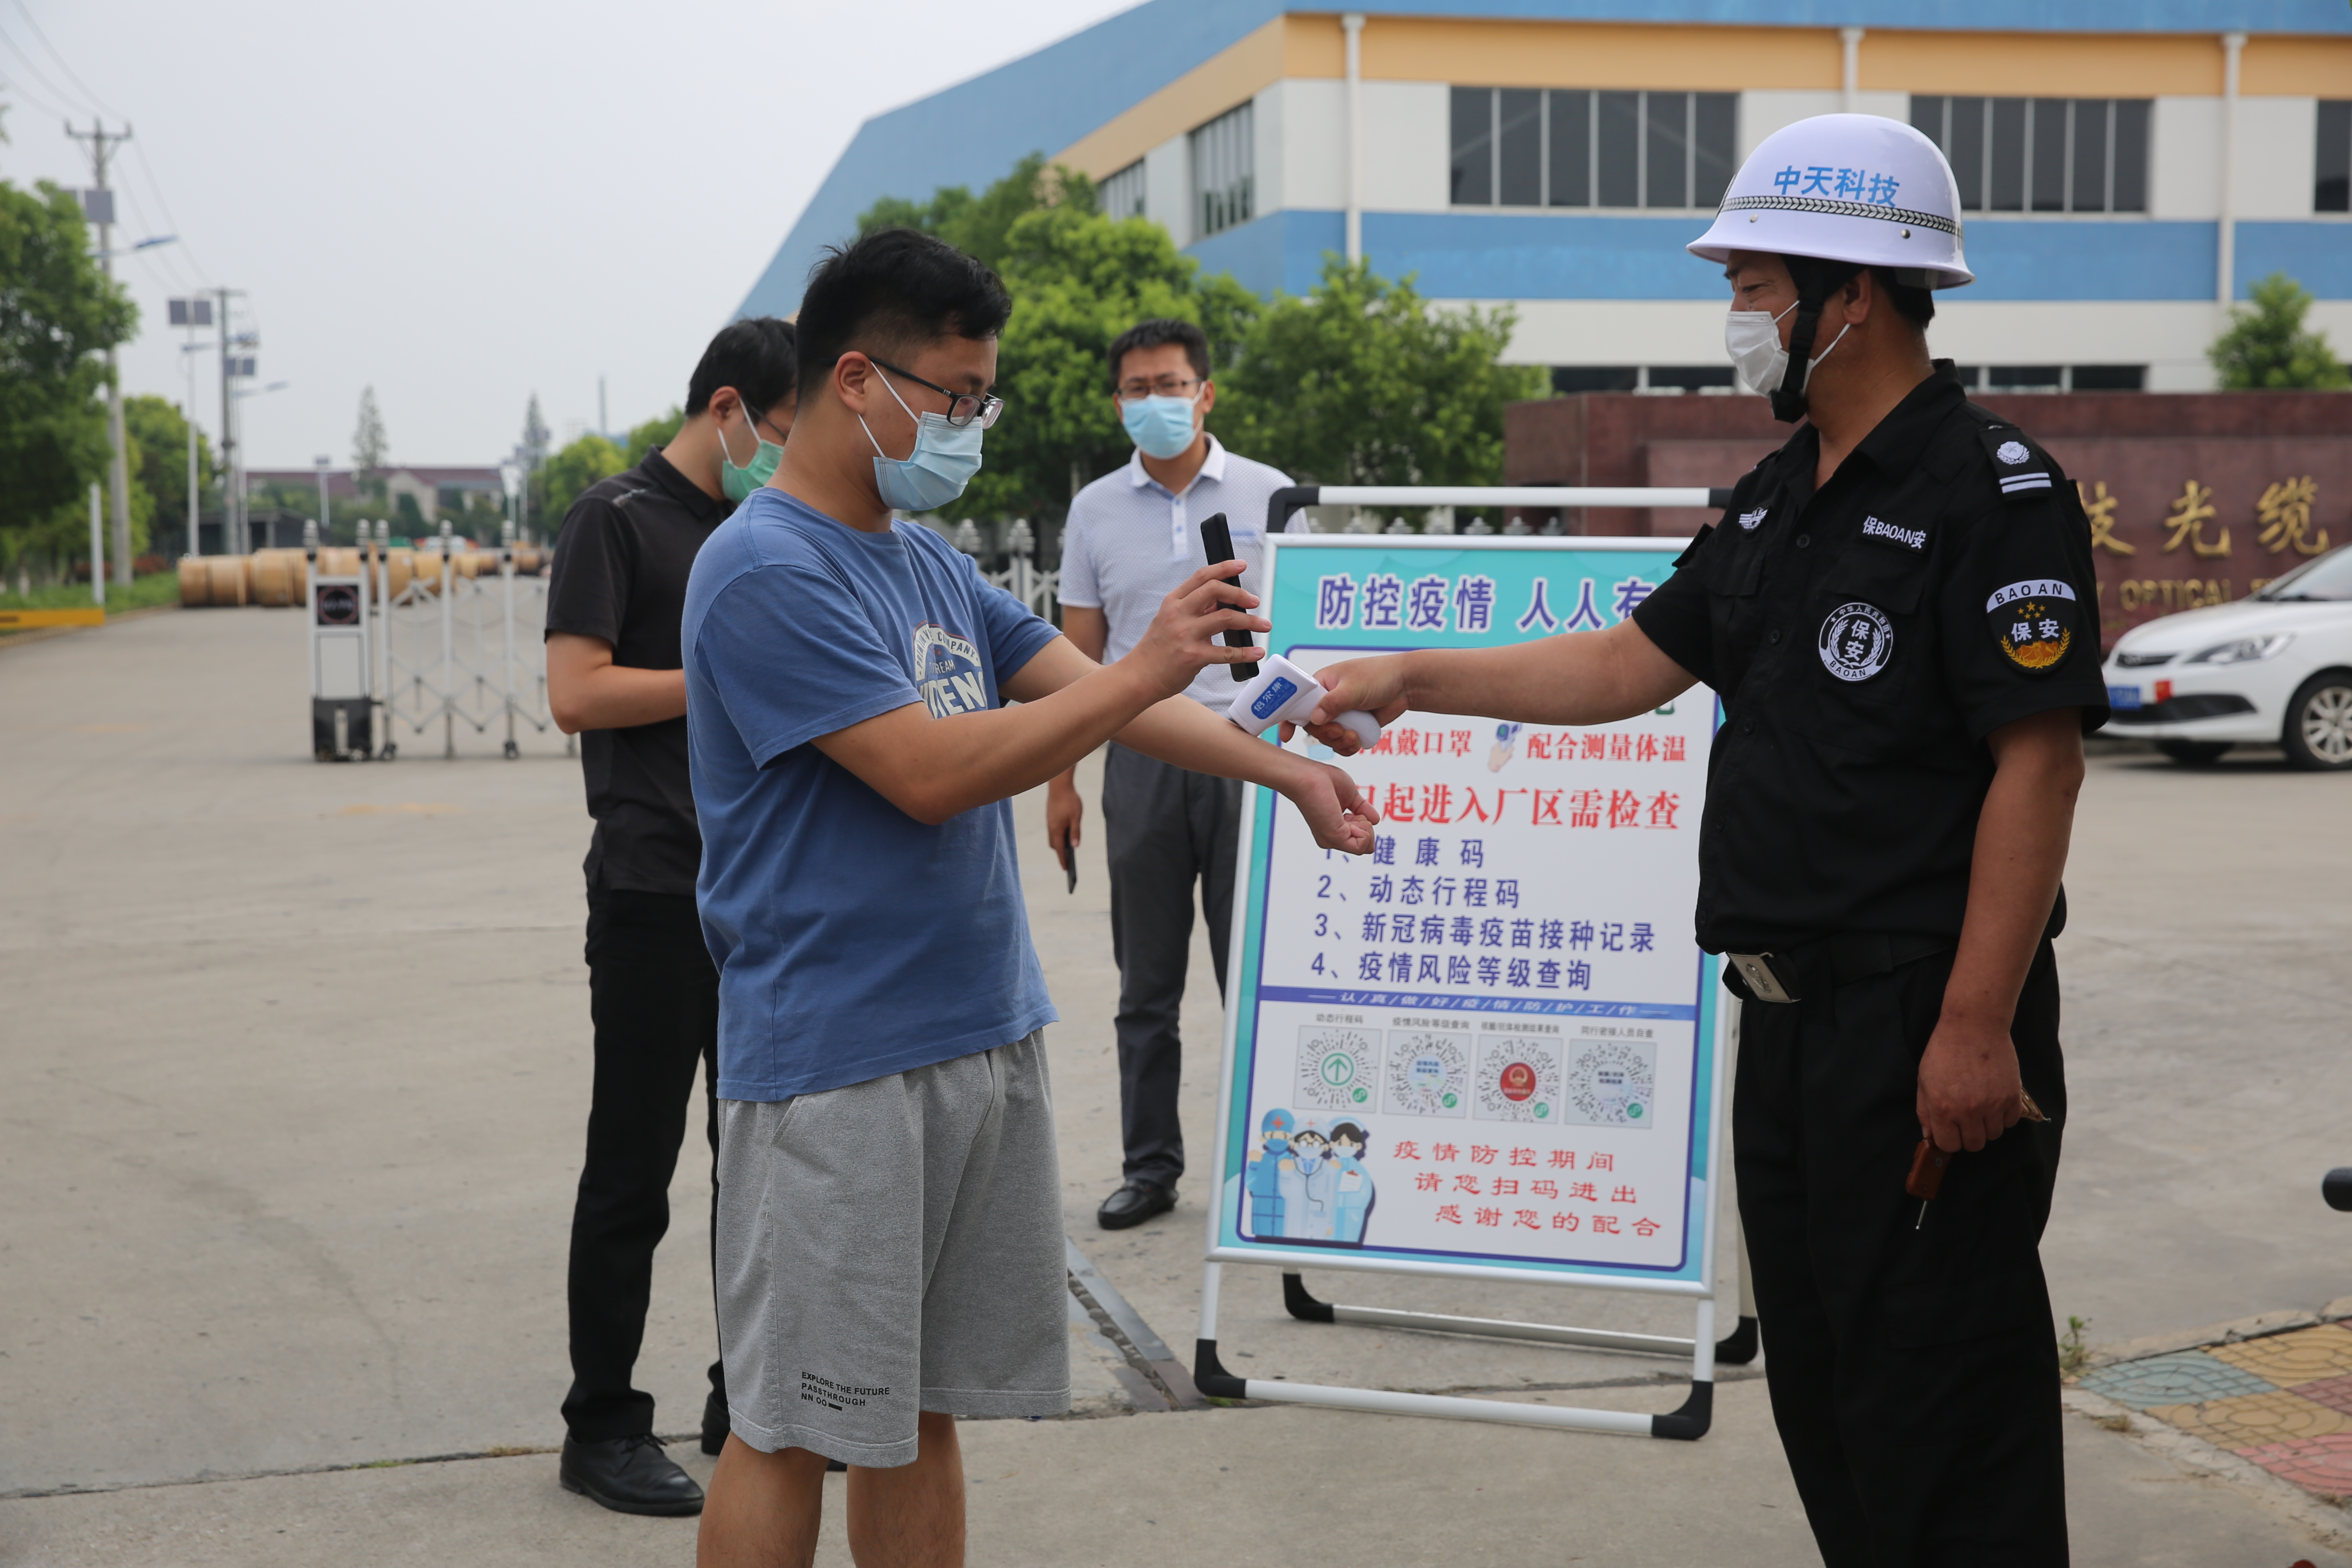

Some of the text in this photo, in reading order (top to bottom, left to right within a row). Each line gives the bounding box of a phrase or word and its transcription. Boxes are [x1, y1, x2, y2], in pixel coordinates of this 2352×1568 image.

[1774, 166, 1900, 208] 中天科技
[1863, 515, 1926, 549] 保BAOAN安
[1318, 575, 1494, 630] 防控疫情
[1839, 605, 1890, 633] 中华人民共和国
[2011, 618, 2059, 642] 保安
[1844, 619, 1870, 661] 保安
[1829, 660, 1866, 678] BAOAN
[1254, 681, 1283, 711] 倍尔康
[1359, 728, 1472, 757] 佩戴口罩
[1528, 732, 1686, 762] 配合测量体温
[1316, 1013, 1363, 1024] 动态行程码
[1392, 1016, 1470, 1029] 疫情风险等级查询
[1393, 1140, 1614, 1172] 疫情防控期间
[1415, 1172, 1637, 1205] 请您扫码进出
[1436, 1204, 1661, 1237] 感谢您的配合
[801, 1392, 813, 1401] NN
[802, 1372, 890, 1396] EXPLORE THE FUTURE
[802, 1383, 865, 1406] PASSTHROUGH
